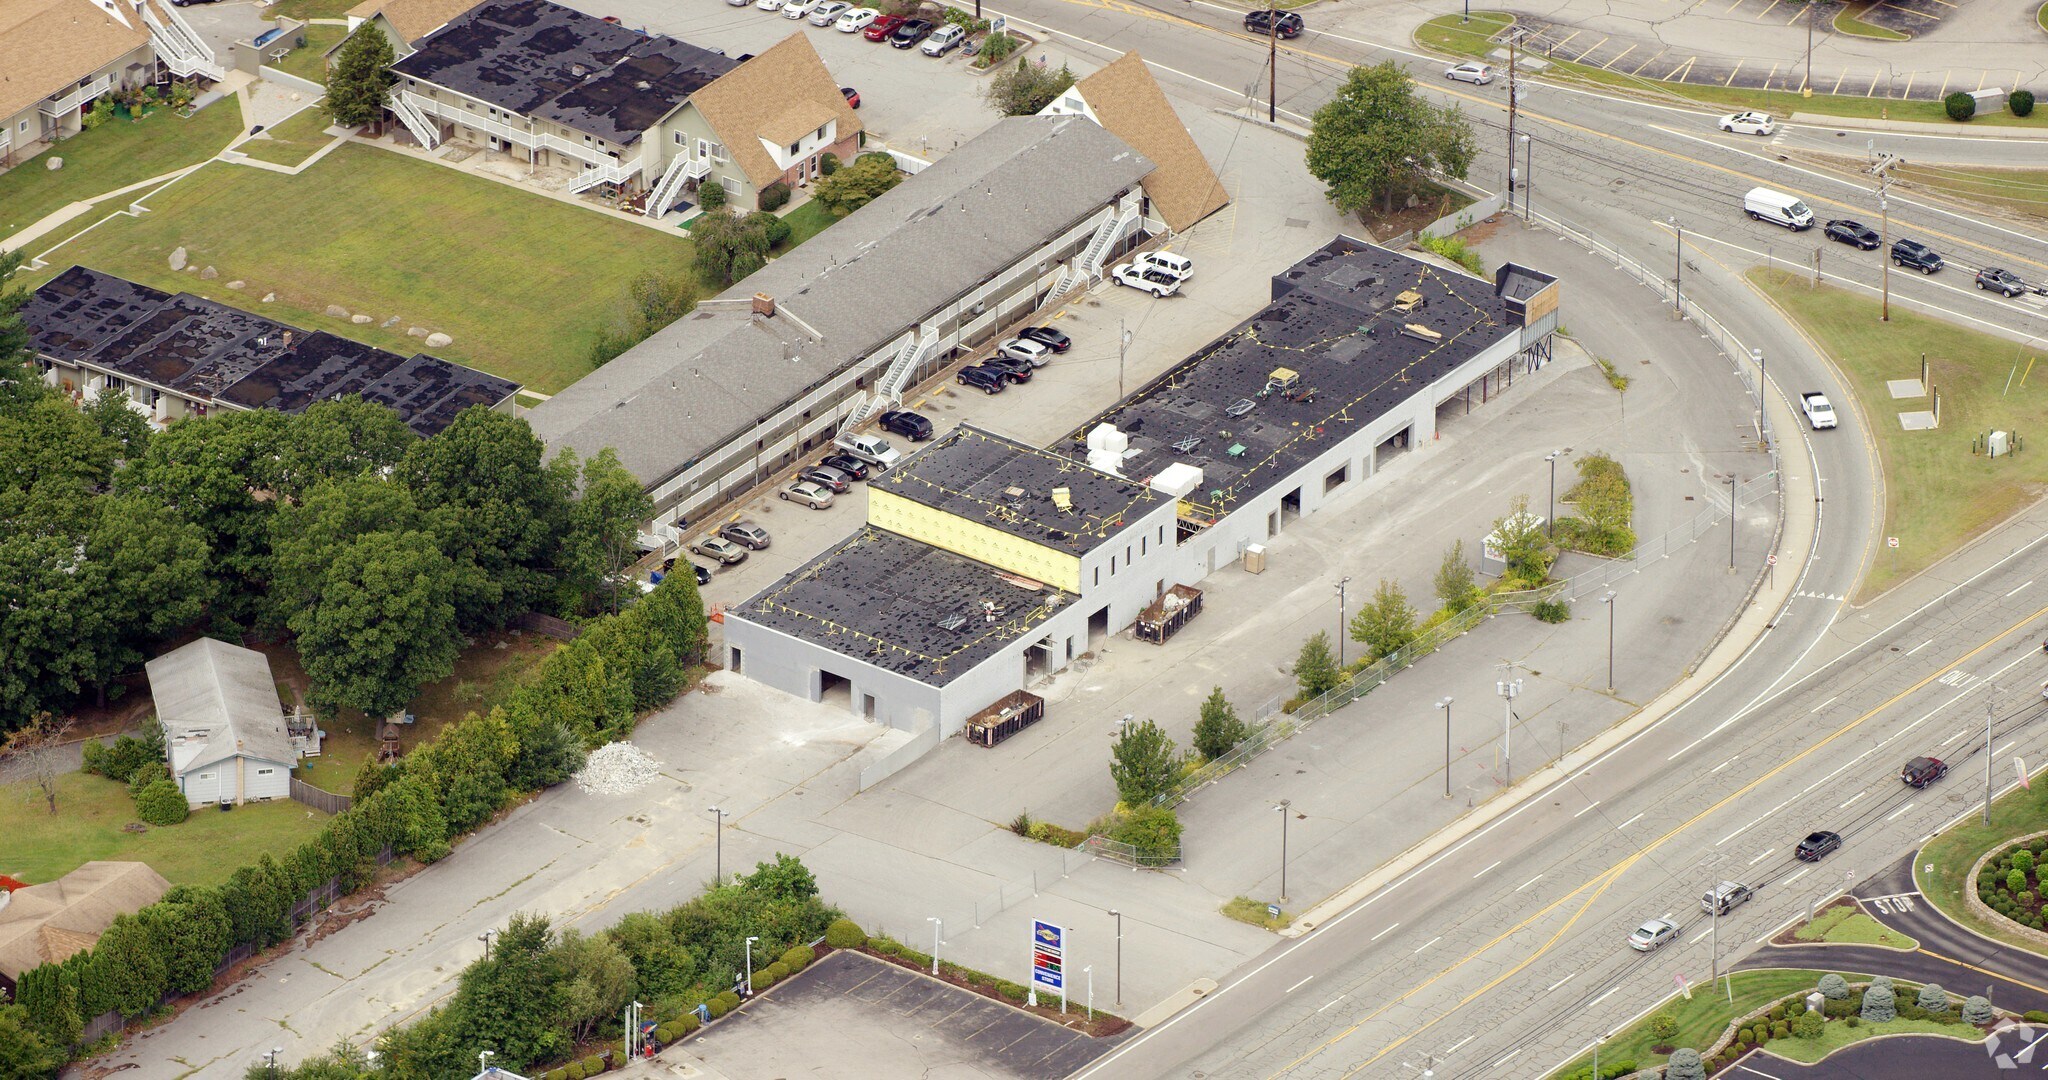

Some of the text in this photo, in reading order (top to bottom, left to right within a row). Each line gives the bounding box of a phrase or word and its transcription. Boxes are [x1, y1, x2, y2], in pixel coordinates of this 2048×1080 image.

[1938, 670, 1979, 688] ONLY
[1874, 896, 1914, 914] STOP
[1035, 969, 1060, 980] CONVENIENCE
